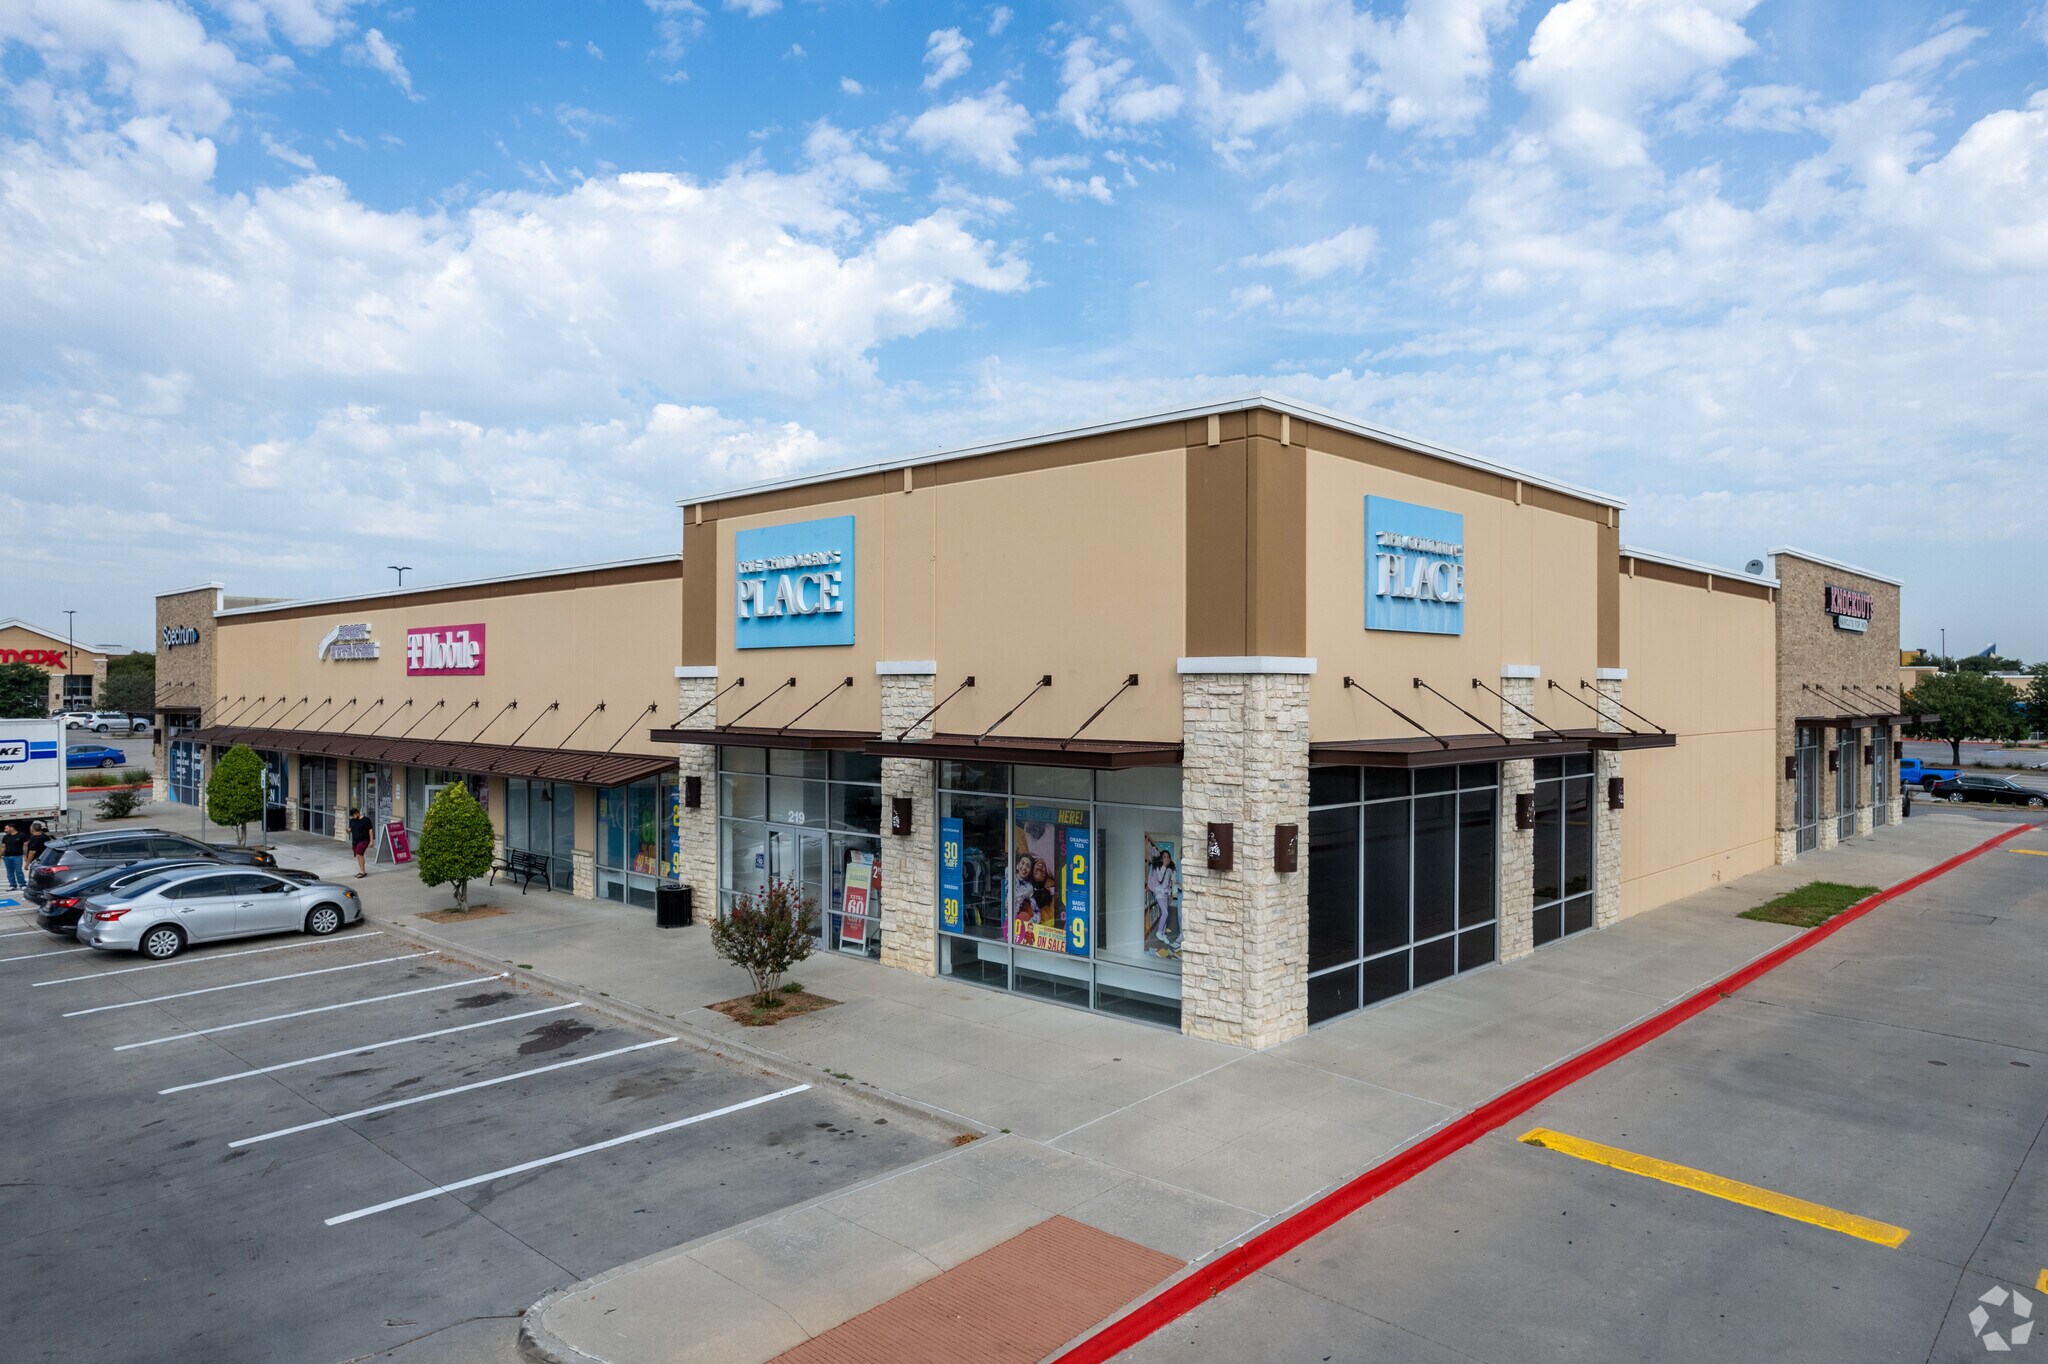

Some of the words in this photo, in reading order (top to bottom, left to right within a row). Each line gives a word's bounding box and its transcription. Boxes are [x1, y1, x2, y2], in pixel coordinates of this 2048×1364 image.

[737, 559, 763, 573] THE
[765, 550, 841, 570] CHILDREN'S
[1376, 553, 1466, 602] PLACE
[737, 571, 843, 618] PLACE
[1831, 587, 1873, 620] KNOCKOUTS
[163, 625, 195, 650] Spectrum
[788, 811, 805, 824] 219
[1058, 810, 1083, 825] HERE!
[1069, 836, 1089, 844] GRAPHIC
[944, 841, 958, 860] 30
[847, 900, 864, 915] 60
[944, 898, 958, 917] 30
[1037, 936, 1047, 948] ON
[1048, 938, 1066, 952] SALE
